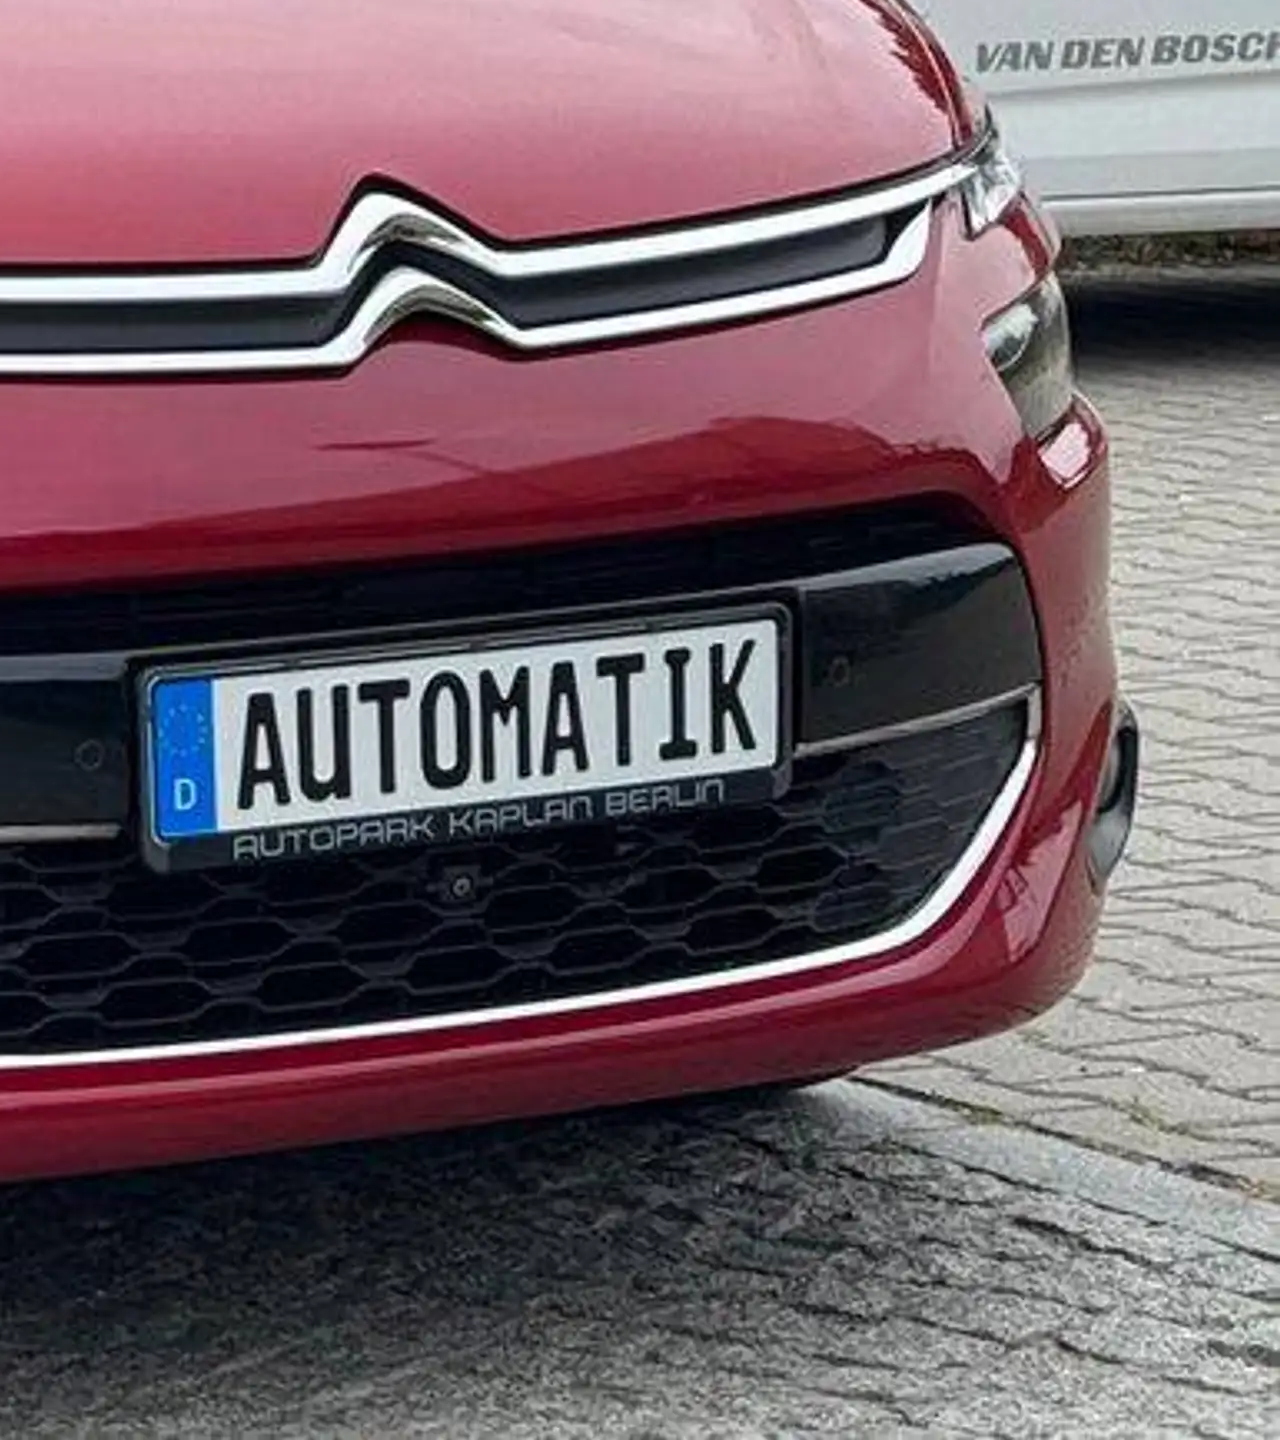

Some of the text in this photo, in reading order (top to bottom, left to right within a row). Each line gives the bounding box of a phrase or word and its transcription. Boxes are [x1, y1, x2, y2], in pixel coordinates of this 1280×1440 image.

[976, 41, 1055, 74] VAN
[1060, 36, 1145, 71] DEN
[237, 637, 759, 812] AUTOMATIK
[174, 778, 194, 812] D
[231, 776, 725, 862] AUTOPARK KAPLAN BERLIN
